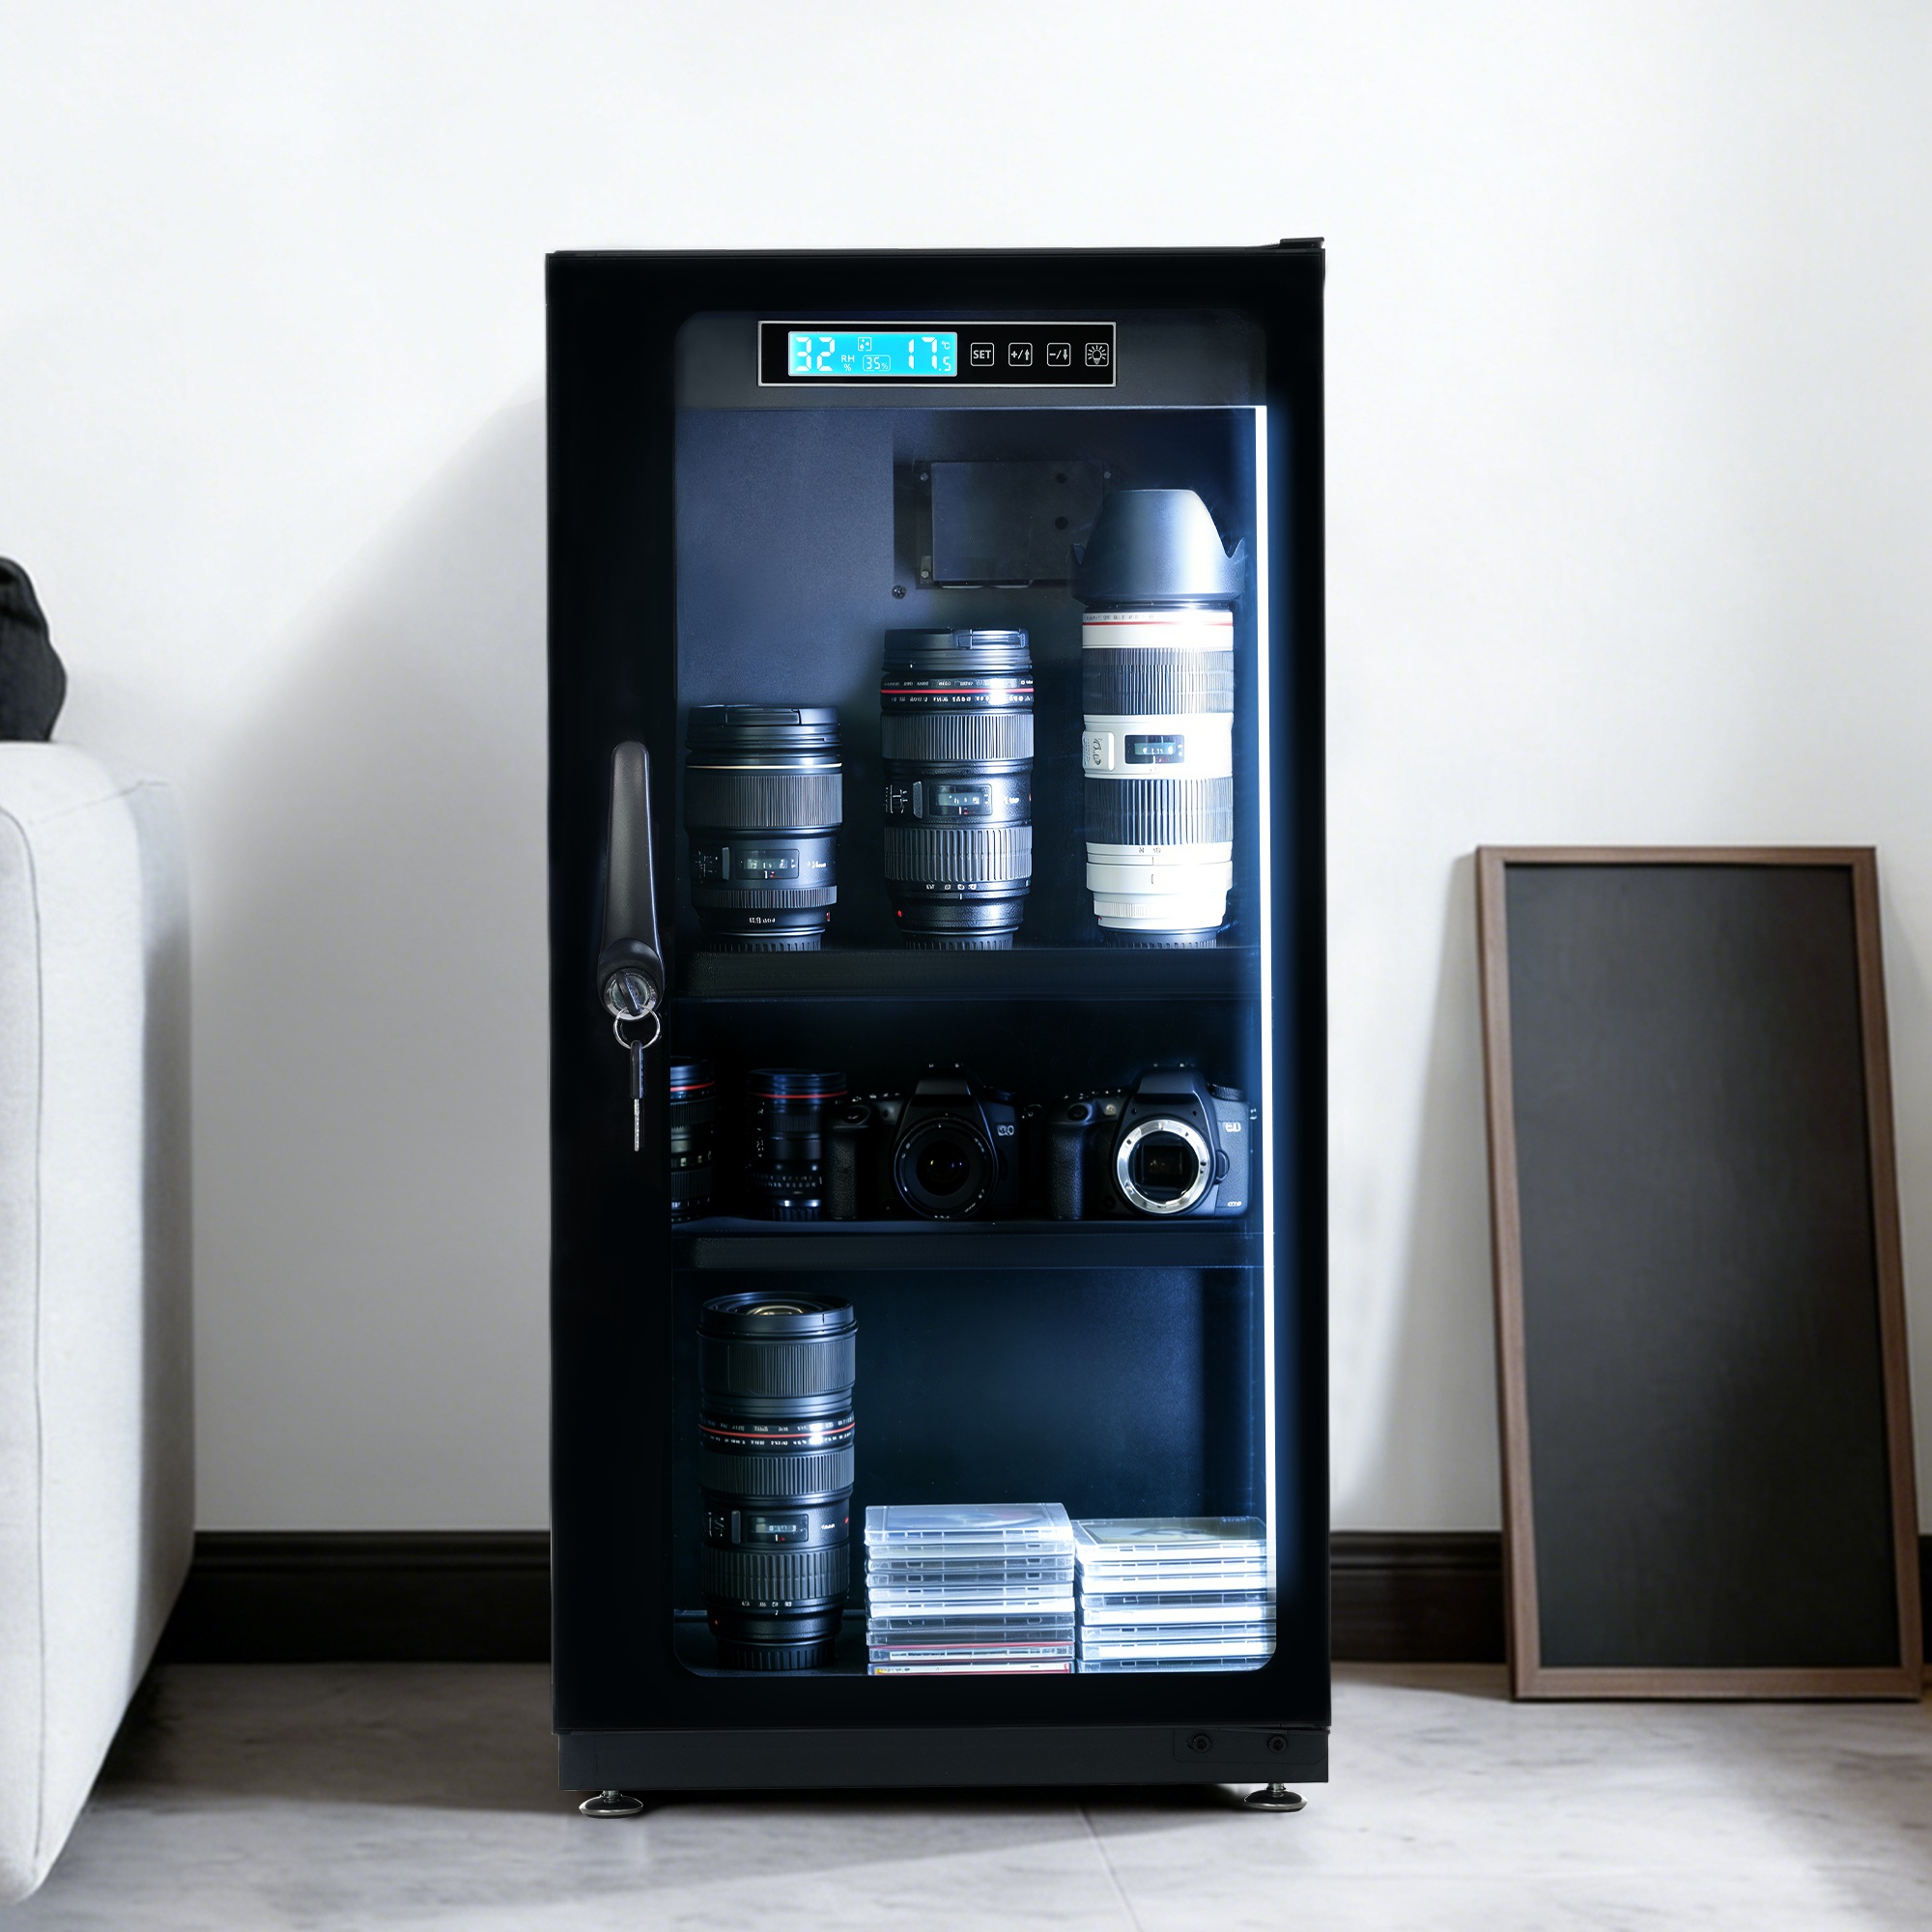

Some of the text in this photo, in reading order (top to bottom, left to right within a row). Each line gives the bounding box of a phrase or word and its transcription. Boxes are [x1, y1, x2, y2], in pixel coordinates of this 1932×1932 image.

[795, 336, 835, 372] 32
[973, 350, 992, 359] SET
[843, 363, 852, 372] %
